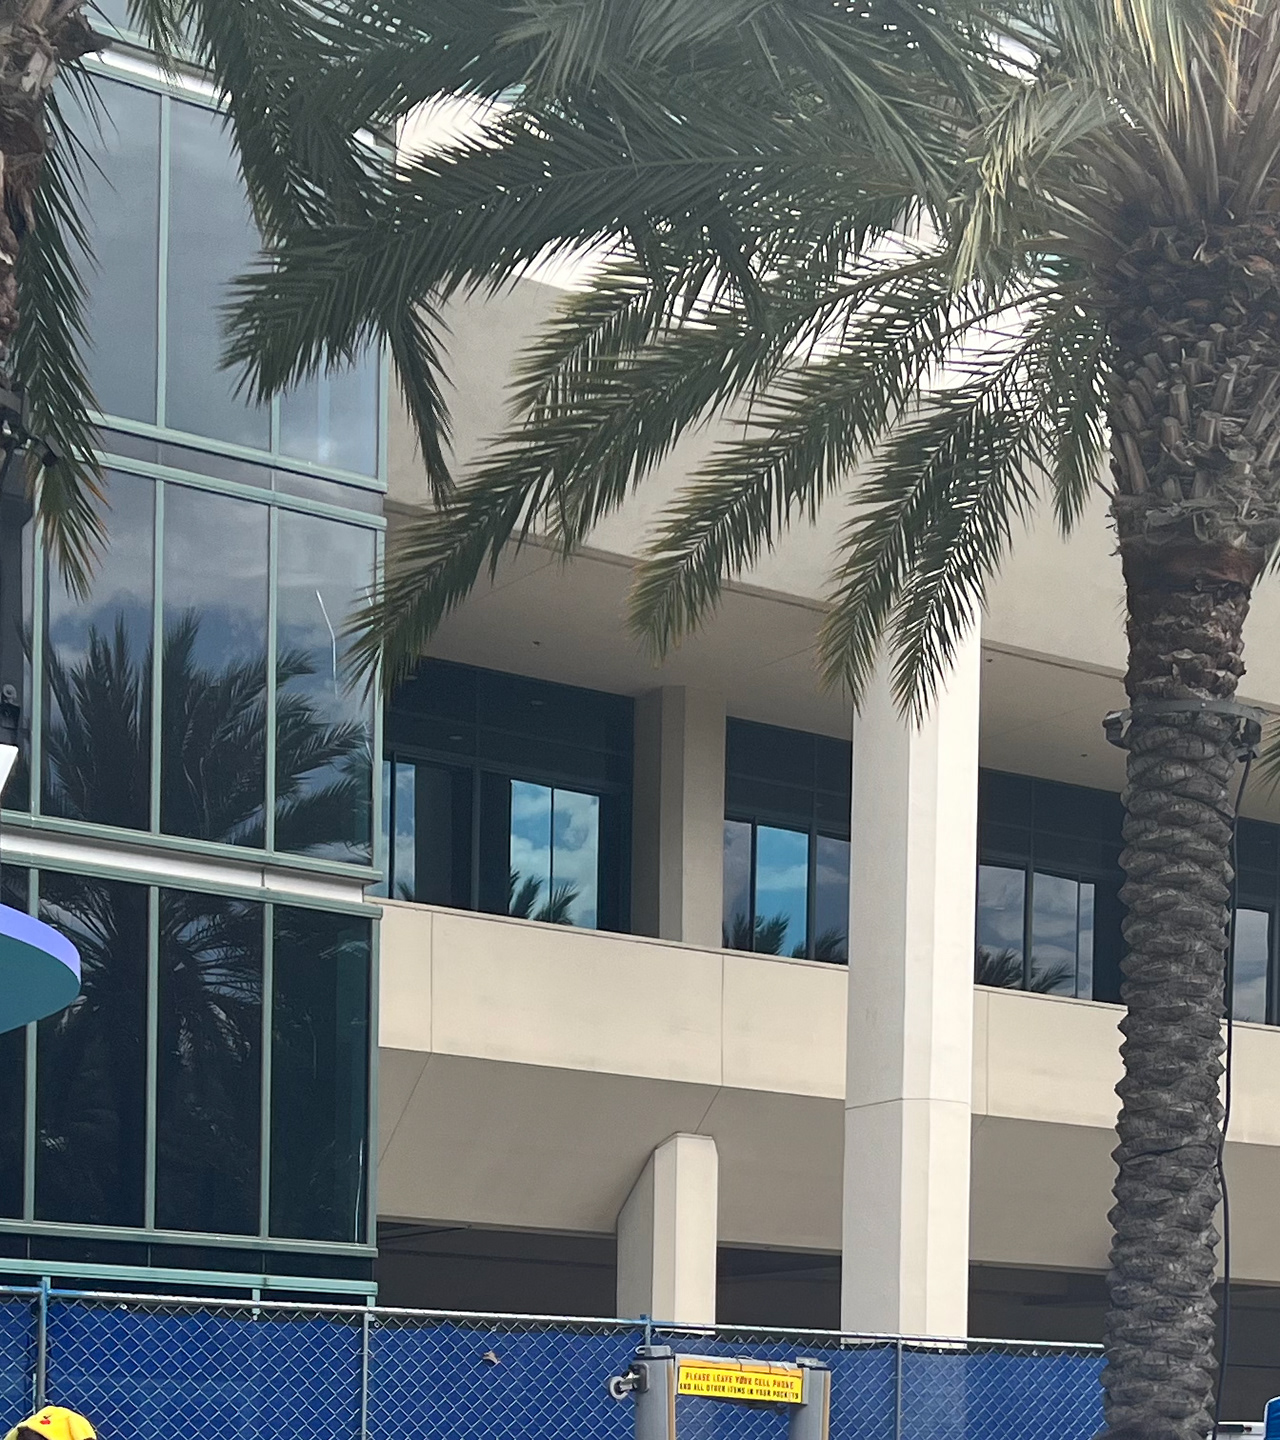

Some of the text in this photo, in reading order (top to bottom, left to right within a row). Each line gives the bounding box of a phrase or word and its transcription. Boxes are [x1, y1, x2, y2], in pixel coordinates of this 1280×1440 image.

[686, 1372, 794, 1389] PLEASE LEAVE YOUR CELL PHONE
